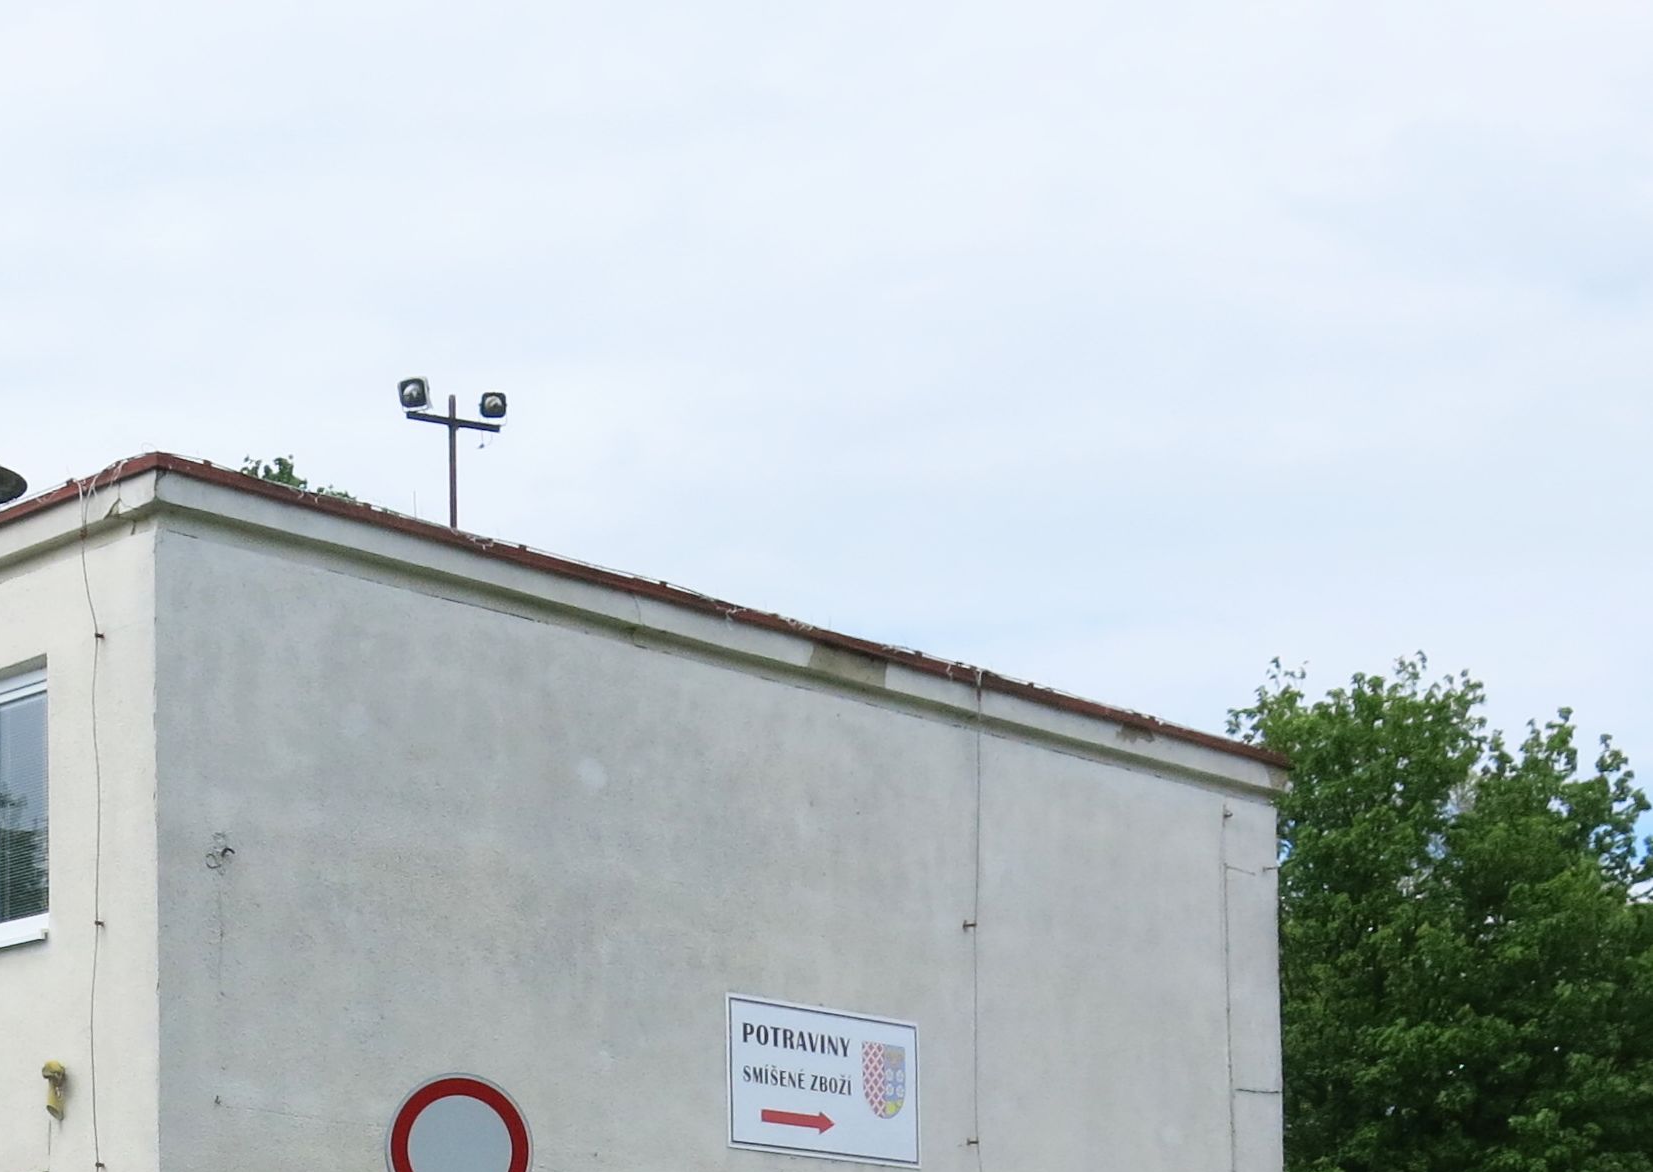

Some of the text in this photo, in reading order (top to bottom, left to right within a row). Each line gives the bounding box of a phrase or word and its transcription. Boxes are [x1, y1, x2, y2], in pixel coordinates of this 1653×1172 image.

[742, 1022, 850, 1057] POTRAVINY
[743, 1064, 852, 1096] SMÍŠENÉ ZBOŽÍ
